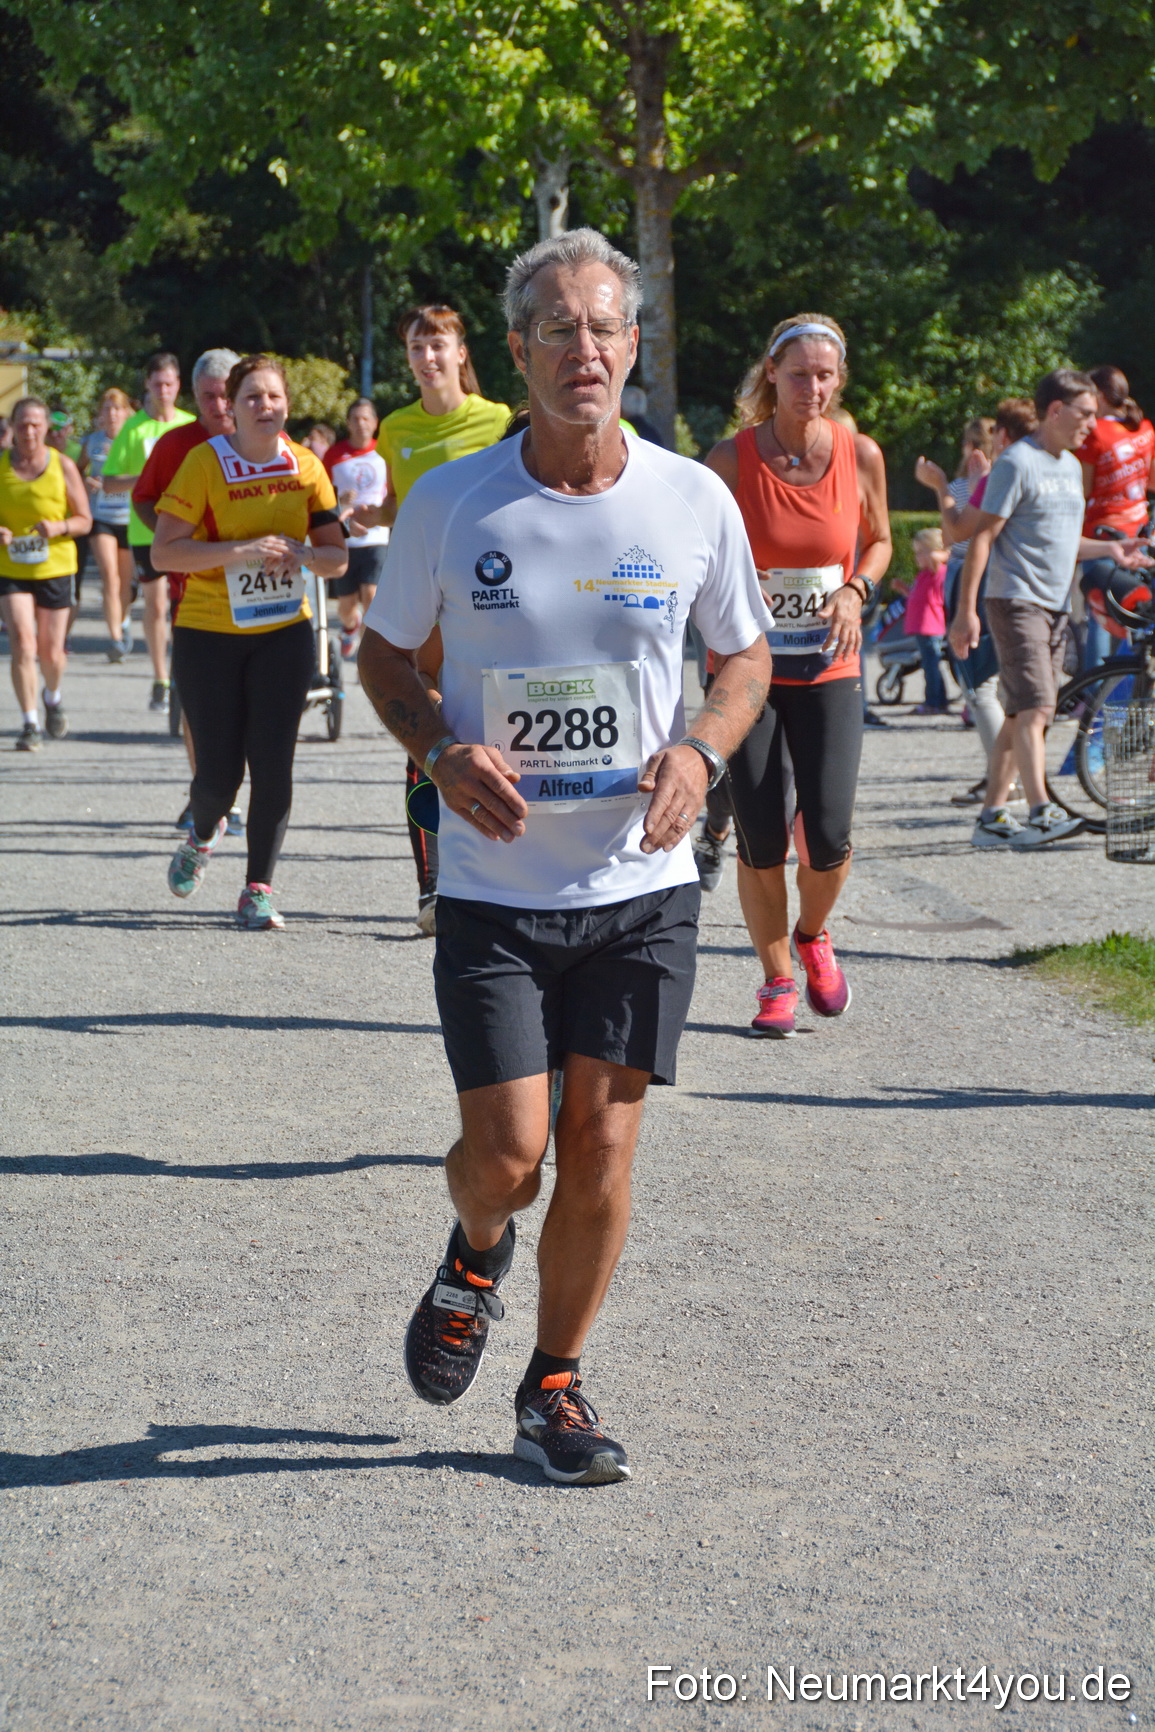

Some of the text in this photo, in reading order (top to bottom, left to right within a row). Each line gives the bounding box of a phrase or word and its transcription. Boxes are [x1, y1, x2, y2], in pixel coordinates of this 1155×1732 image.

[228, 484, 264, 501] MAX
[238, 569, 294, 595] 2414
[573, 579, 600, 592] 14.
[471, 588, 520, 602] PARTL
[252, 604, 288, 617] Jennifer
[473, 600, 520, 611] Neumarkt
[771, 591, 829, 619] 2341
[783, 633, 820, 645] Monika
[526, 679, 596, 697] BOCK
[507, 705, 619, 753] 2288
[520, 757, 599, 768] PARTL Neumarkt
[538, 776, 594, 797] Alfred
[445, 1291, 459, 1299] 2288
